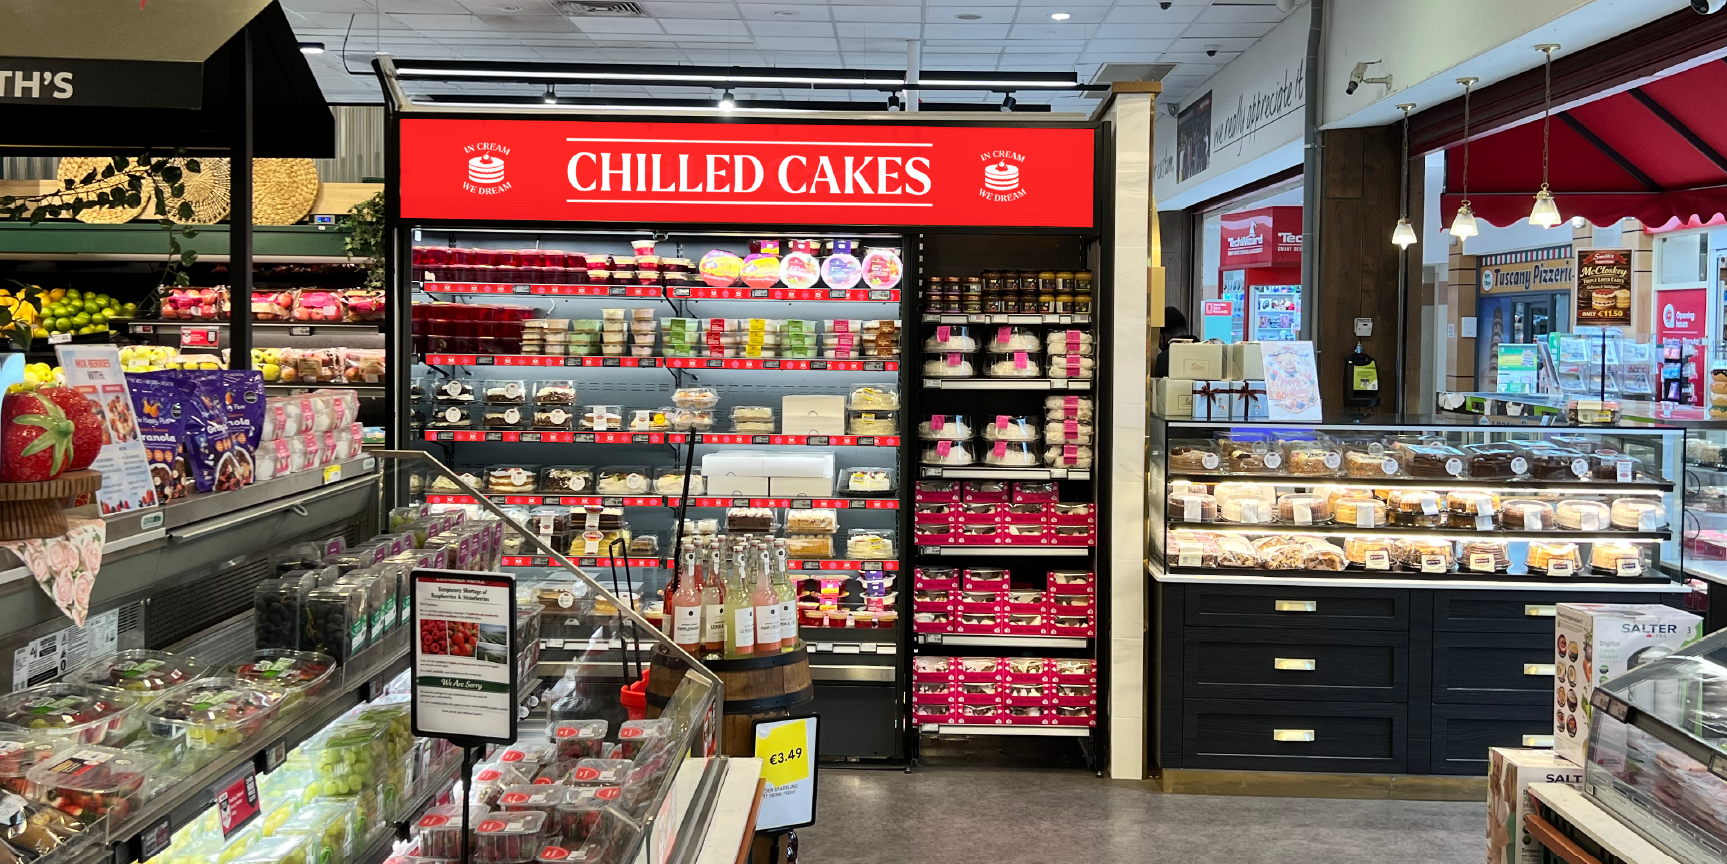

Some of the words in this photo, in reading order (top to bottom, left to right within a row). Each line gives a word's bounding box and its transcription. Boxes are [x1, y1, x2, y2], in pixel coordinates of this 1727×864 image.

[1213, 123, 1223, 148] we
[1223, 93, 1246, 157] really
[1246, 68, 1293, 145] appreciate
[463, 144, 476, 154] IN
[476, 142, 511, 156] CREAM
[979, 151, 992, 163] IN
[992, 150, 1026, 163] CREAM
[566, 152, 764, 193] CHILLED
[777, 155, 933, 197] CAKES
[462, 181, 478, 194] WE
[478, 181, 513, 195] DREAM
[978, 189, 994, 201] WE
[994, 188, 1027, 203] DREAM
[1227, 234, 1263, 248] TechWizard
[1580, 265, 1628, 278] McCloskey
[1494, 268, 1532, 290] Tuscany
[141, 433, 176, 443] ranola
[437, 586, 461, 594] Temporary
[463, 587, 482, 596] Shortage
[1620, 623, 1677, 634] SALTER
[1599, 640, 1621, 648] Digital
[440, 678, 453, 686] We
[453, 679, 465, 688] Are
[464, 680, 483, 691] Sorry
[769, 747, 803, 766] €3.49
[1545, 774, 1584, 783] SALT
